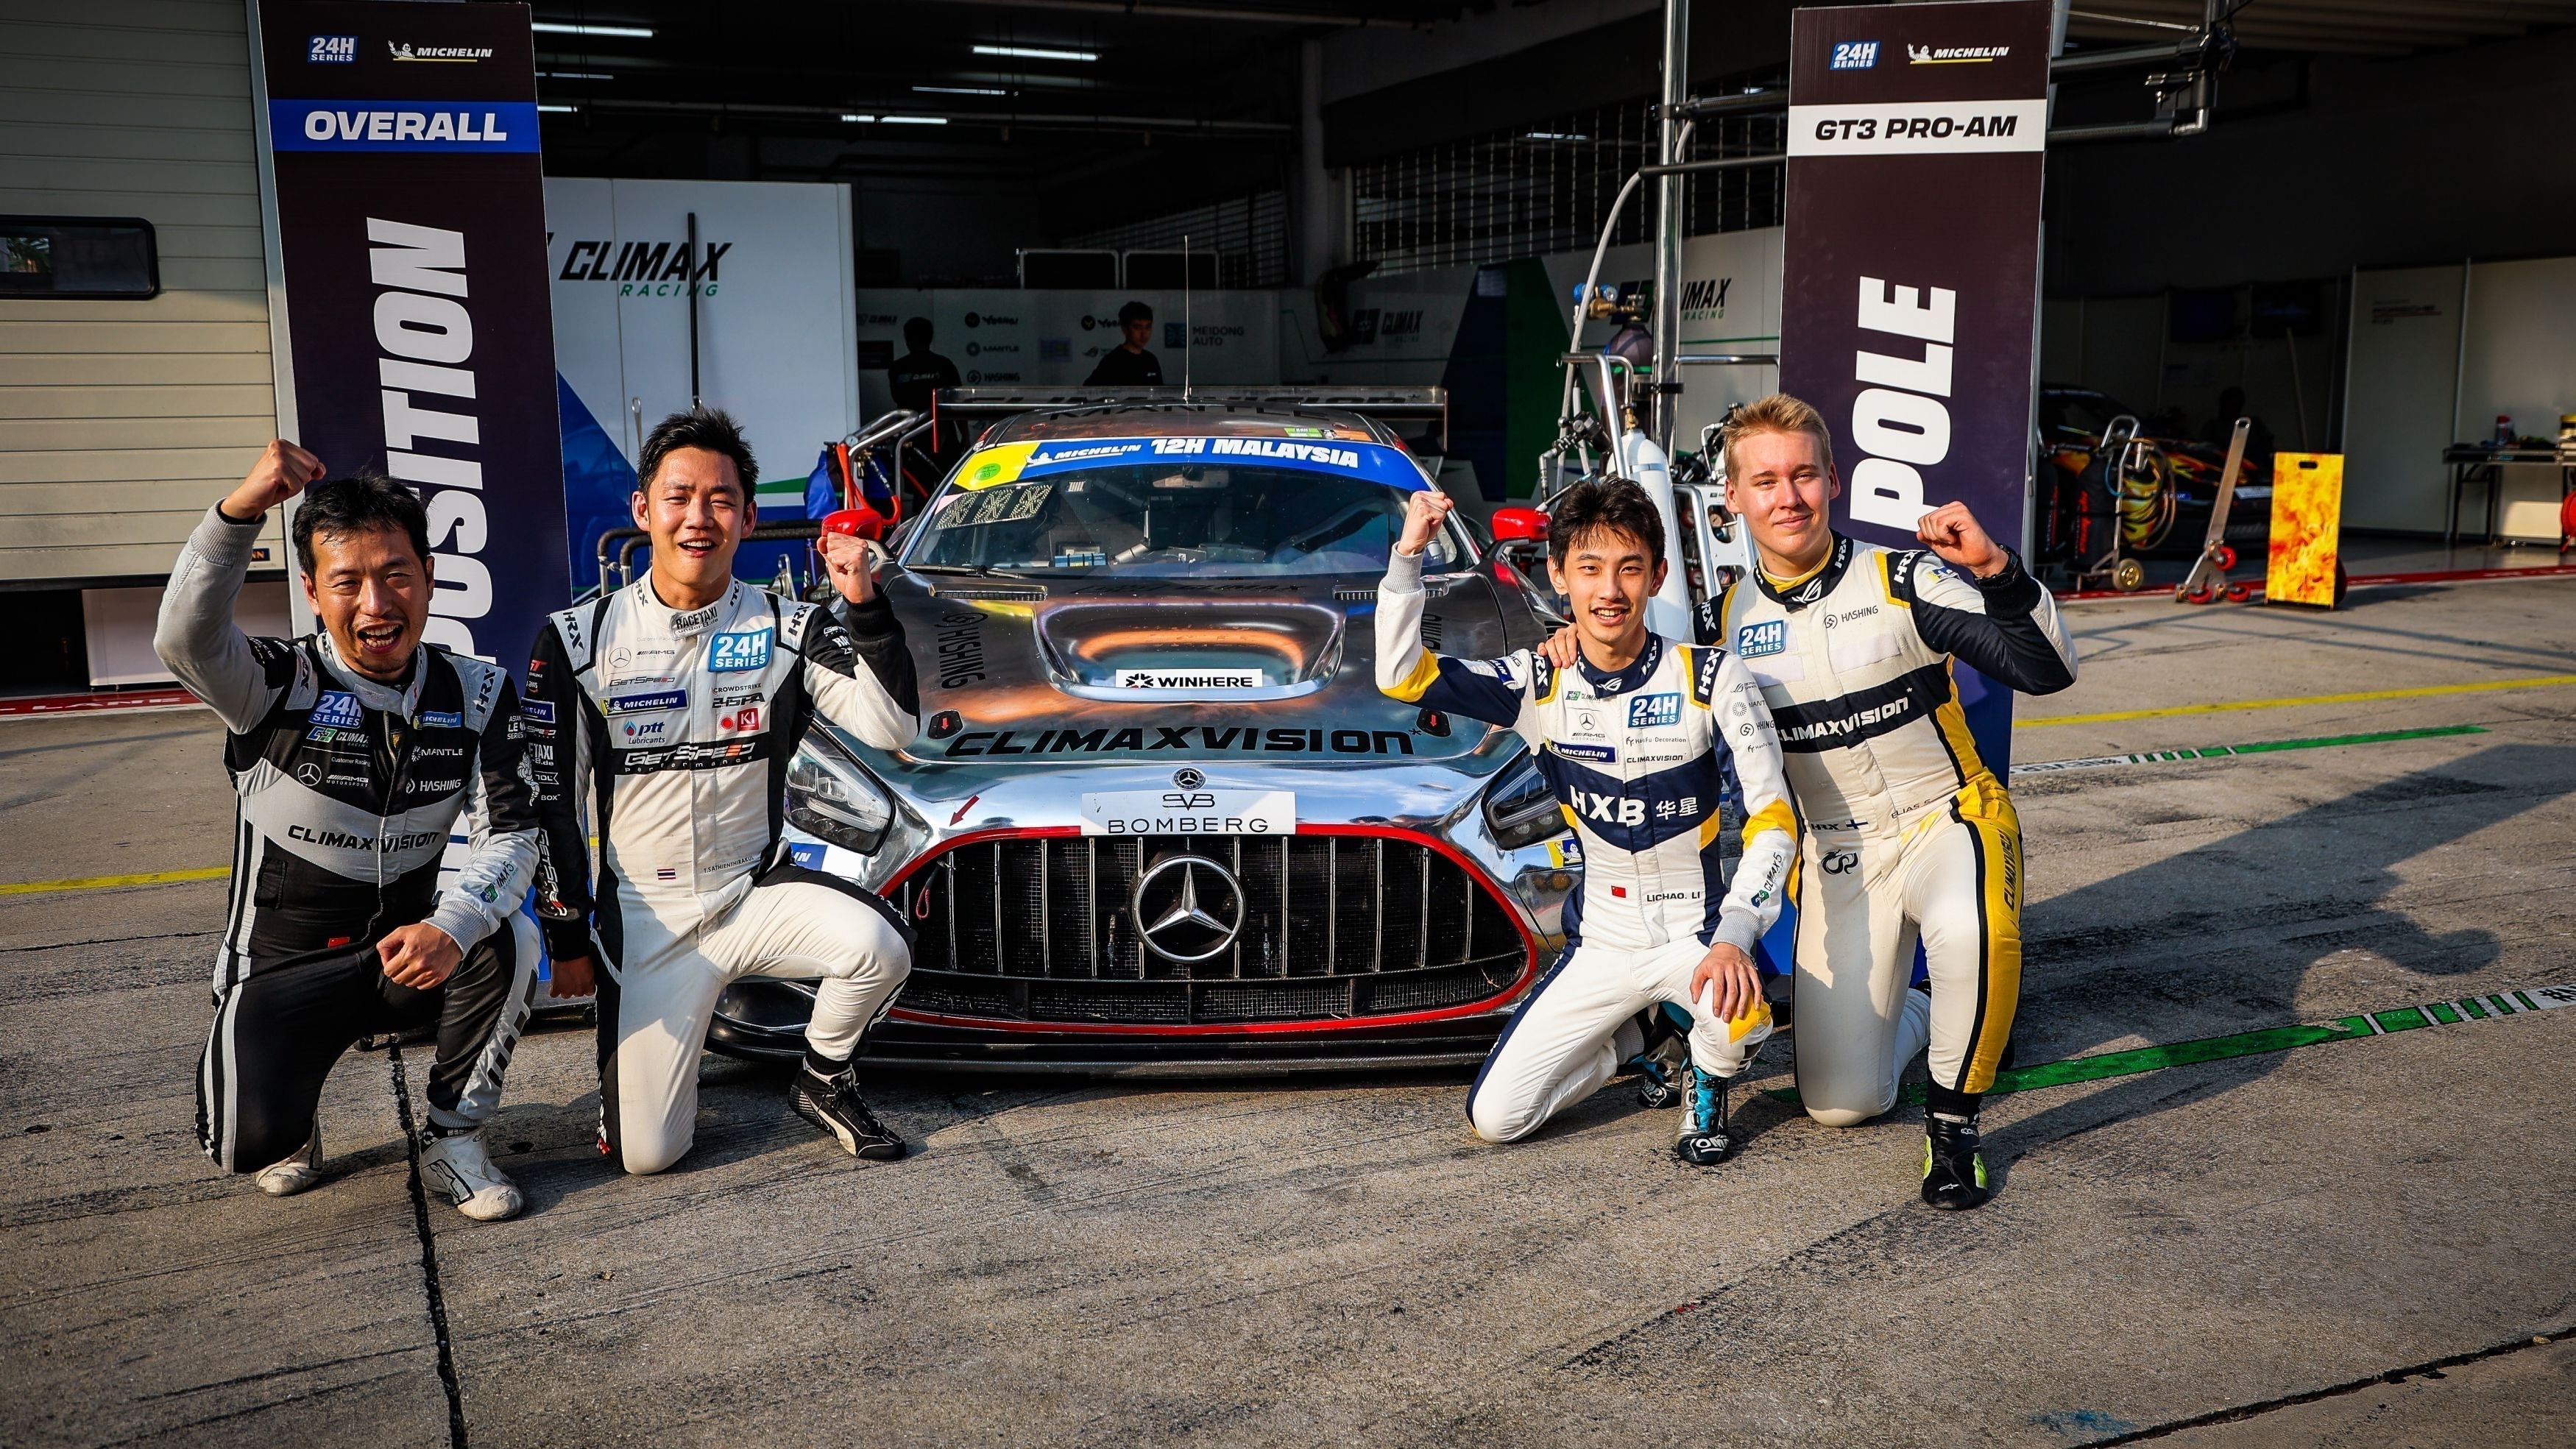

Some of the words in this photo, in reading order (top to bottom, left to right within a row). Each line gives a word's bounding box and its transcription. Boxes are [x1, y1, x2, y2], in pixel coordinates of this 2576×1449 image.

[312, 38, 355, 54] 24H
[417, 48, 493, 57] MICHELIN
[1836, 43, 1878, 60] 24H
[1933, 46, 2010, 58] MICHELIN
[1833, 60, 1873, 68] SERIES
[305, 111, 507, 141] OVERALL
[1815, 119, 1878, 141] GT3
[1885, 115, 2019, 138] PRO-AM
[559, 241, 733, 281] CLIMAX
[1381, 310, 1423, 334] CLIMAX
[1684, 309, 1725, 320] RACING
[1193, 326, 1244, 336] MEIDONG
[1193, 337, 1223, 346] AUTO
[1850, 276, 1956, 539] POLE
[1054, 444, 1141, 460] MICHELIN
[1151, 439, 1206, 454] 12H
[1211, 439, 1359, 469] MALAYSIA
[1894, 551, 1919, 584] HRX
[676, 606, 718, 629] RACETAXI
[788, 604, 810, 637] HRX
[1701, 601, 1716, 631] HRX
[1841, 605, 1879, 623] HASHING
[563, 612, 584, 650] HRX
[1741, 623, 1782, 647] 24H
[716, 631, 767, 658] 24H
[1741, 642, 1782, 656] SERIES
[715, 655, 766, 668] SERIES
[938, 628, 986, 690] HASHING
[1698, 649, 1722, 695] HRX
[714, 683, 762, 693] CROWDSTRIKE
[1158, 676, 1253, 688] WINHERE
[475, 667, 498, 715] HRX
[316, 695, 362, 718] 24H
[521, 706, 546, 715] CHELIN
[624, 697, 678, 709] MICHELIN
[1632, 695, 1678, 718] 24H
[313, 713, 361, 726] SERIES
[740, 712, 756, 725] KI
[1632, 715, 1677, 726] SERIES
[507, 731, 524, 740] SERIES
[638, 721, 665, 736] ptt
[629, 737, 666, 745] Lubricants
[331, 757, 354, 765] Customer
[1561, 748, 1608, 758] MICHELIN
[420, 779, 462, 792] HASHING
[1569, 784, 1646, 827] HXB
[1656, 797, 1699, 821] 华星
[1892, 804, 1920, 819] ELIAS
[1108, 818, 1269, 834] BOMBERG
[1646, 893, 1688, 902] LICHAO.
[1691, 891, 1700, 899] LI
